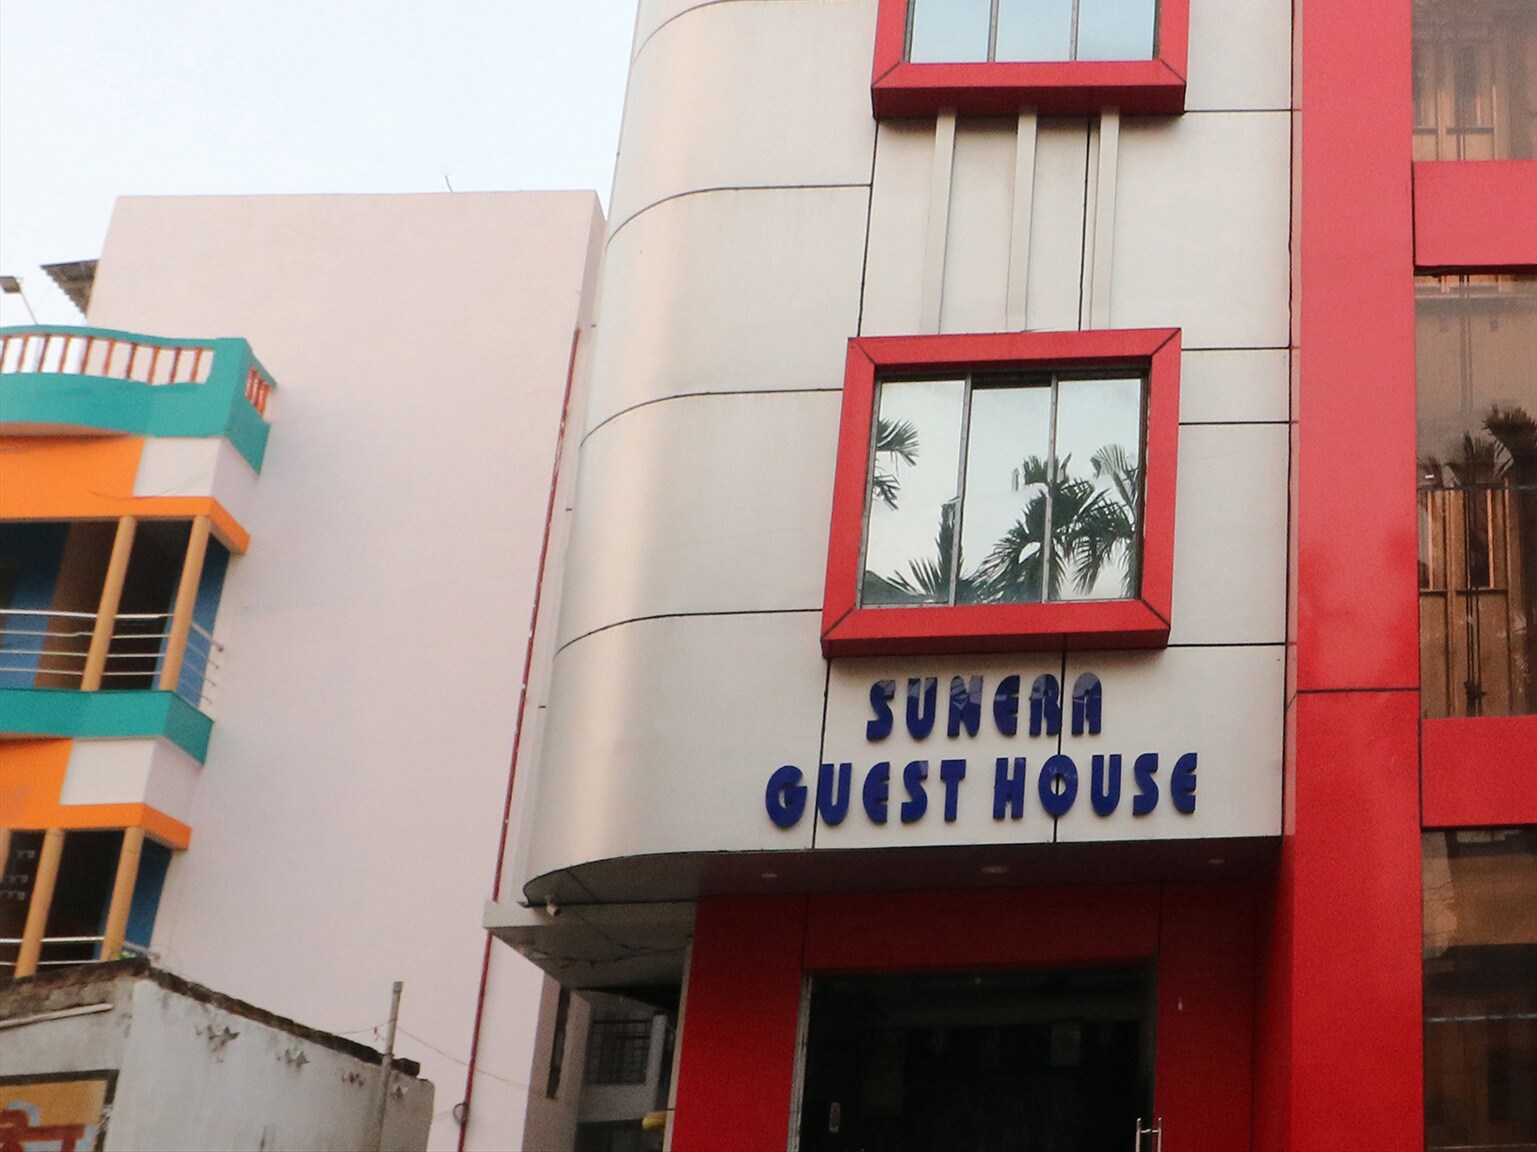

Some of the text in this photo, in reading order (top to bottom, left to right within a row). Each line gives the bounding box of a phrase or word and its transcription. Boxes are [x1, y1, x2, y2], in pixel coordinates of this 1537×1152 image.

[866, 673, 1102, 742] SUNERA
[765, 752, 1198, 829] GUEST HOUSE
